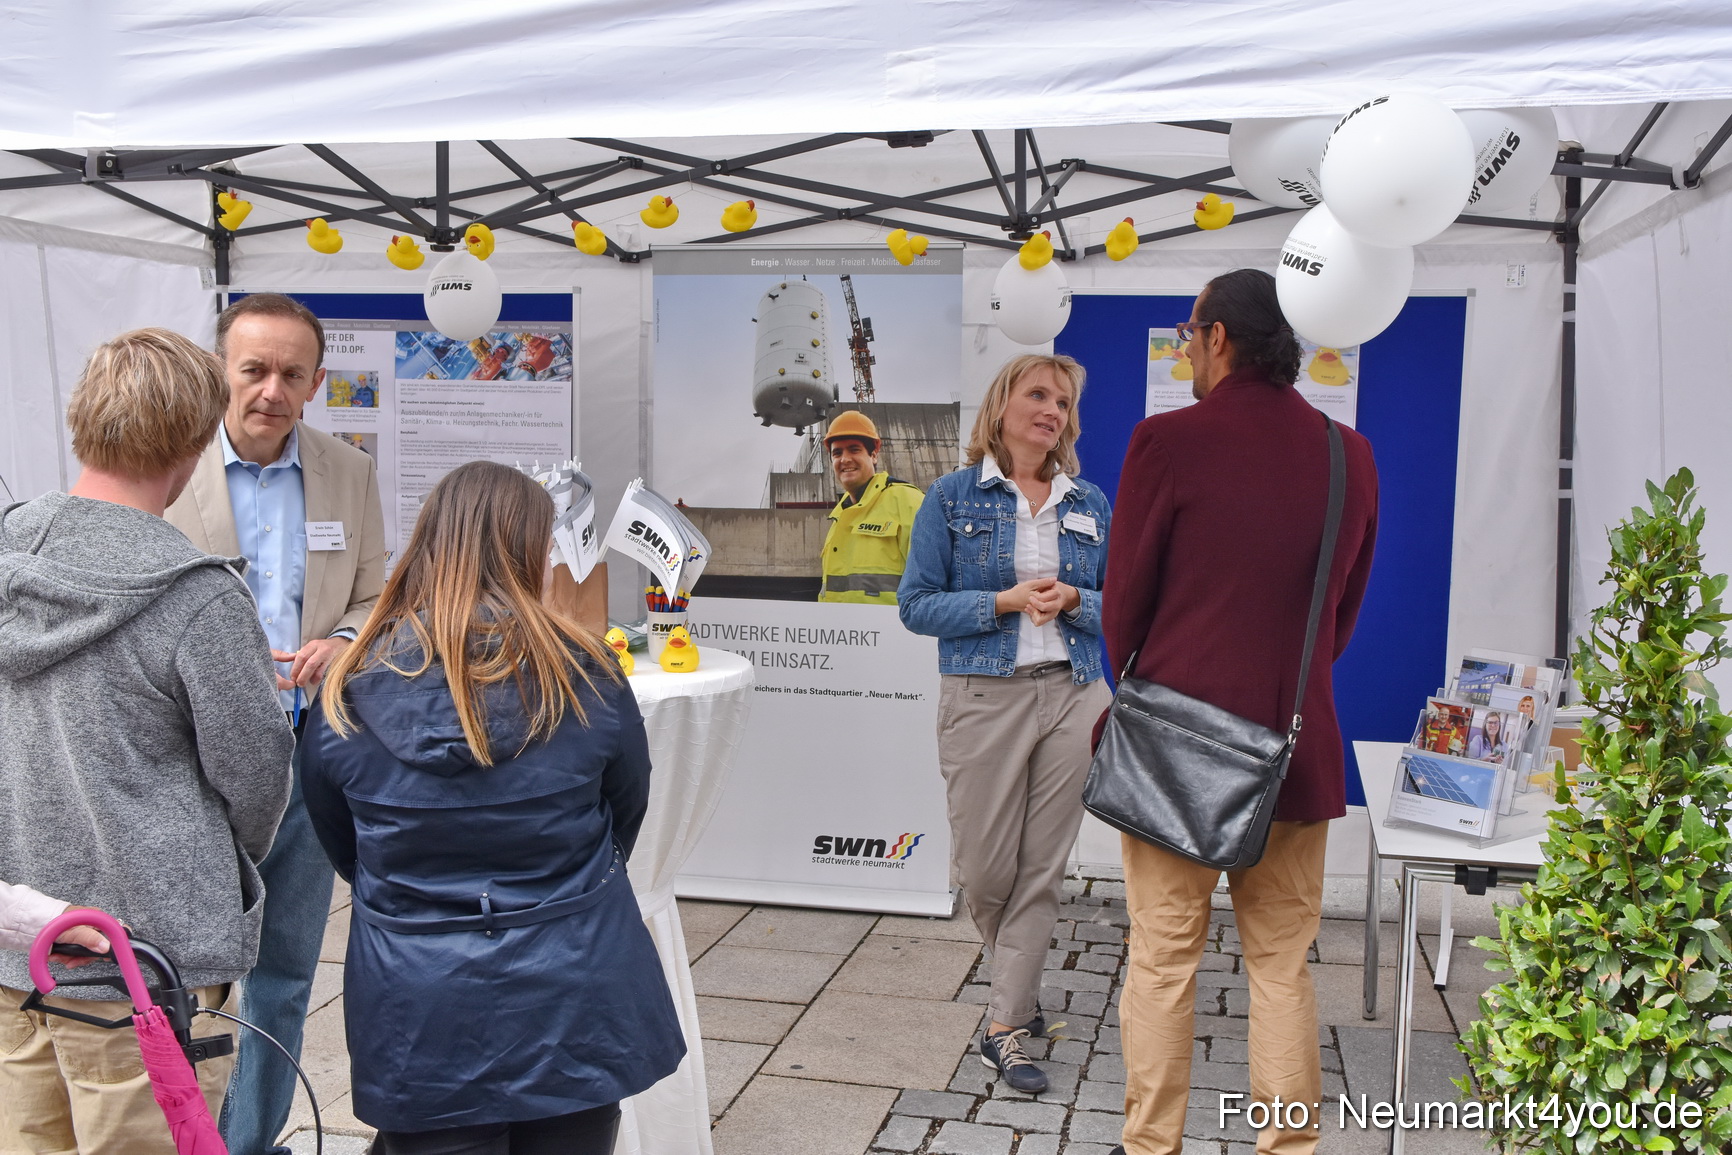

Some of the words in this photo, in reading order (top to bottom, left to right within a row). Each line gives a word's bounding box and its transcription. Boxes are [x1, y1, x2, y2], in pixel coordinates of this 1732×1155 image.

[1477, 131, 1521, 186] swn
[751, 258, 779, 268] Energie
[785, 258, 810, 266] Wasser
[816, 258, 836, 266] Netze
[842, 258, 865, 266] Freizeit
[872, 258, 900, 266] Mobilit
[1283, 252, 1324, 277] swn
[441, 282, 472, 290] swn
[339, 334, 354, 342] DER
[336, 346, 366, 354] I.D.OPF.
[858, 522, 882, 532] swn
[624, 533, 657, 556] stadtwerke
[627, 520, 670, 561] swn
[688, 623, 780, 643] ADTWERKE
[785, 628, 880, 647] NEUMARKT
[761, 651, 834, 670] EINSATZ.
[809, 687, 863, 697] Stadtquartier
[812, 835, 887, 858] swn
[812, 856, 860, 866] stadtwerke
[862, 860, 905, 869] neumarkt
